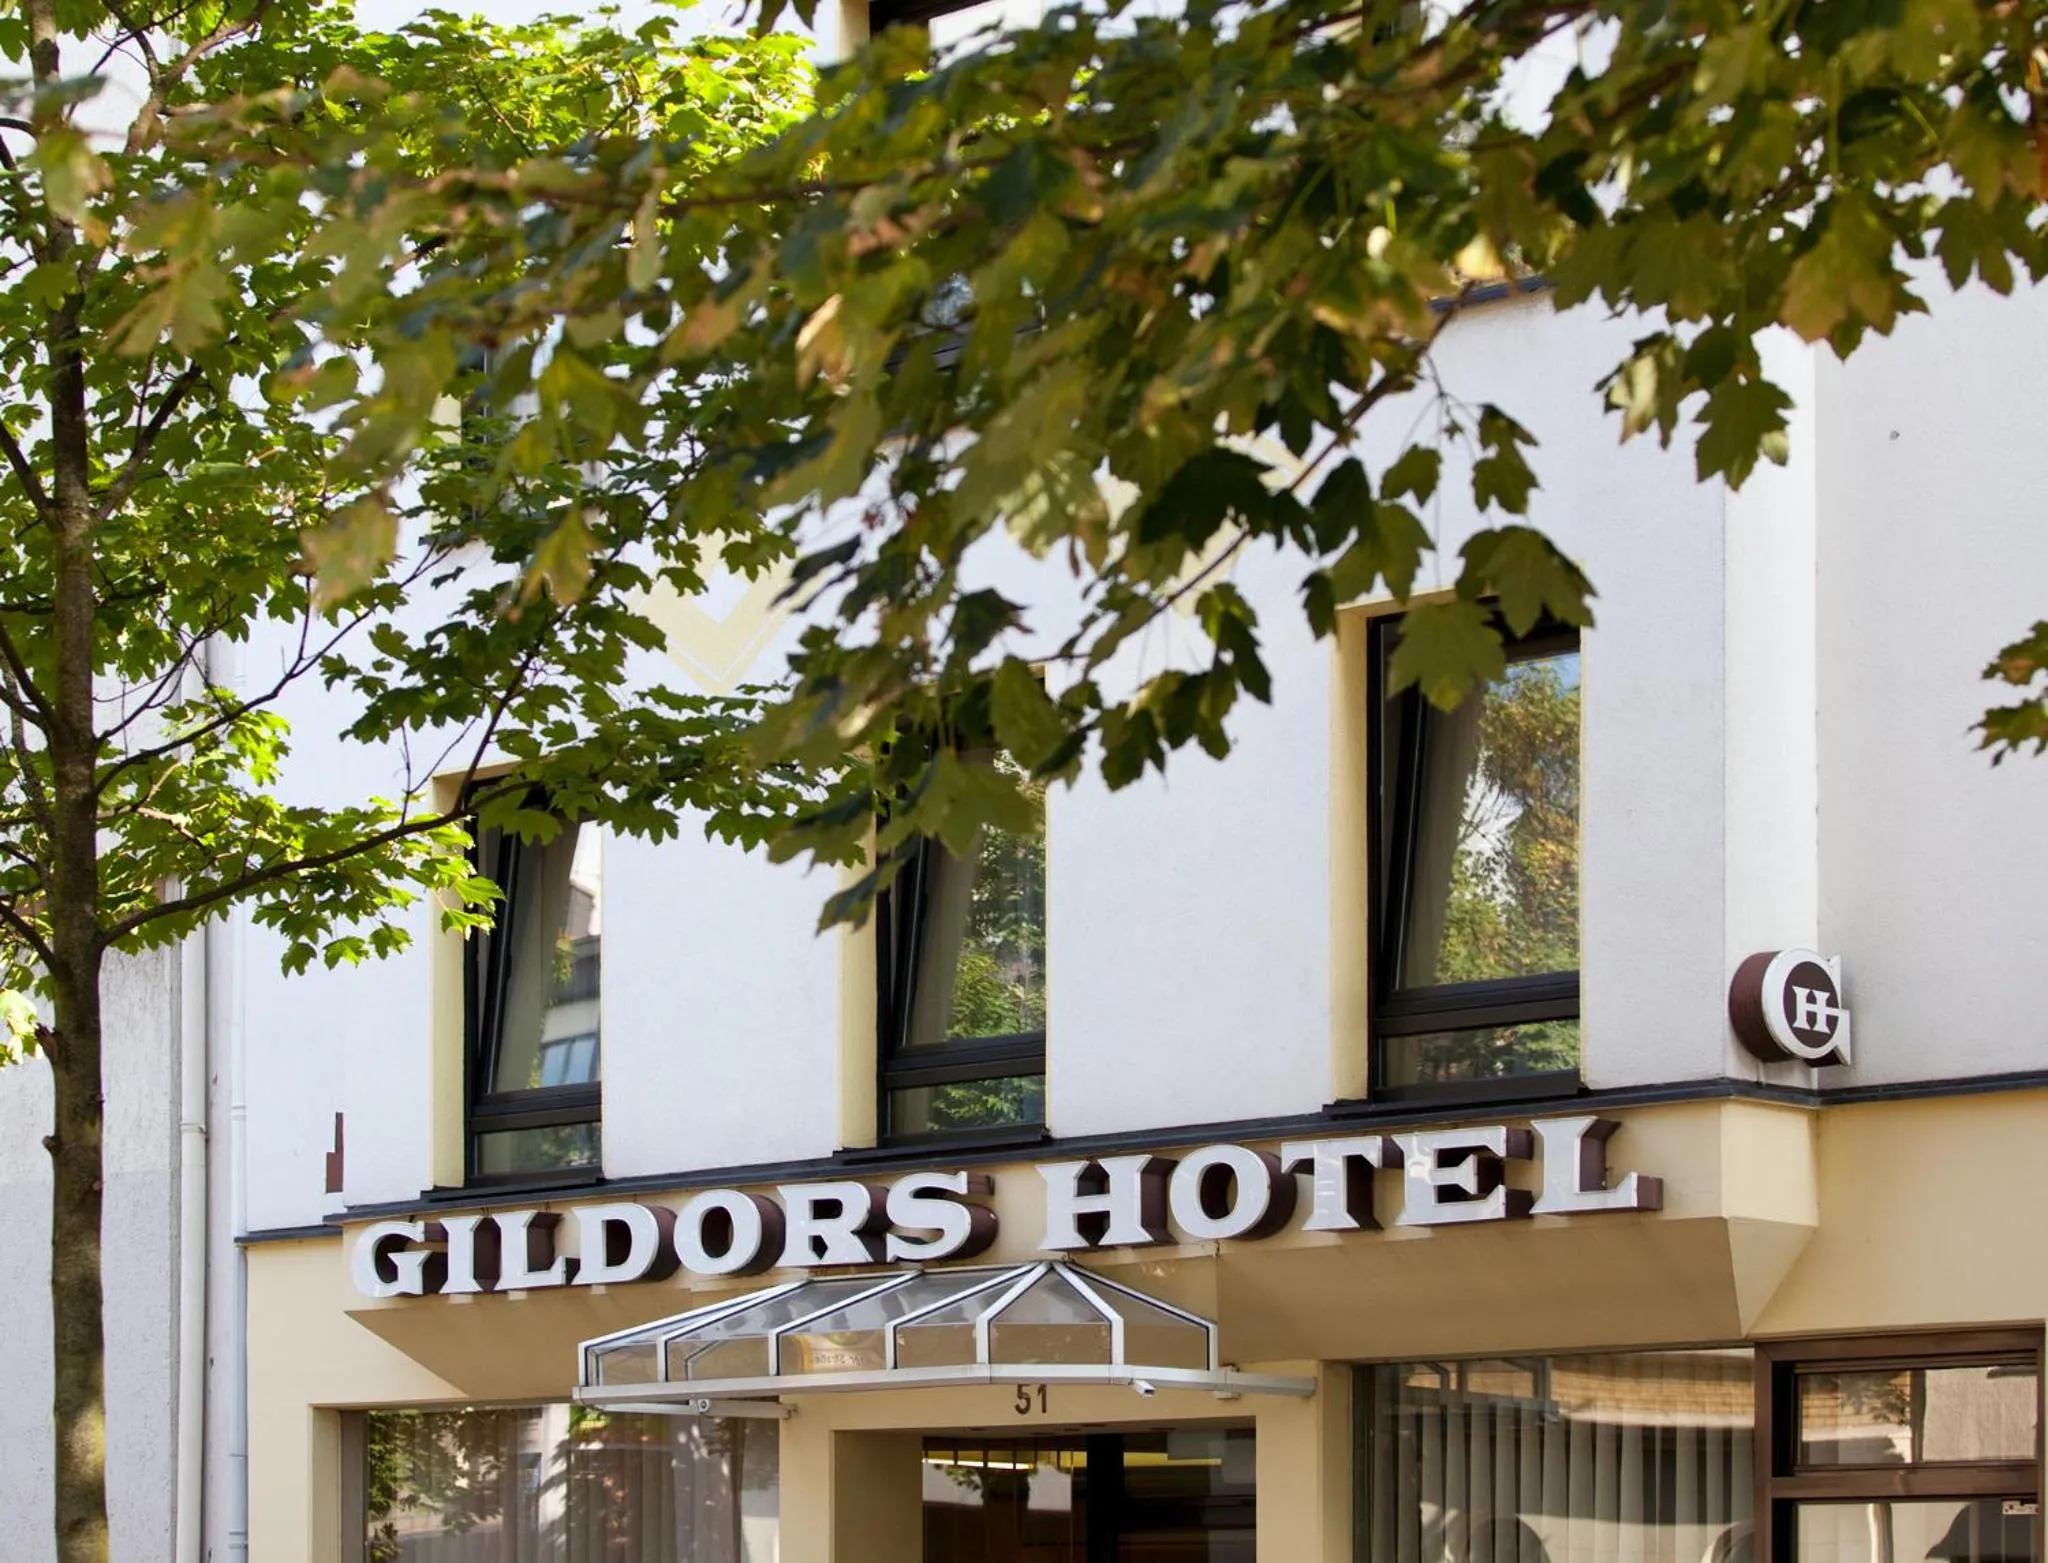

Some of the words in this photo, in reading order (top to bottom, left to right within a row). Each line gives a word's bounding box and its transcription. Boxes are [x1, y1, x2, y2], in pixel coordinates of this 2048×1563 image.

[350, 1171, 972, 1297] GILDORS
[1035, 1115, 1639, 1250] HOTEL
[1015, 1383, 1047, 1415] 51
